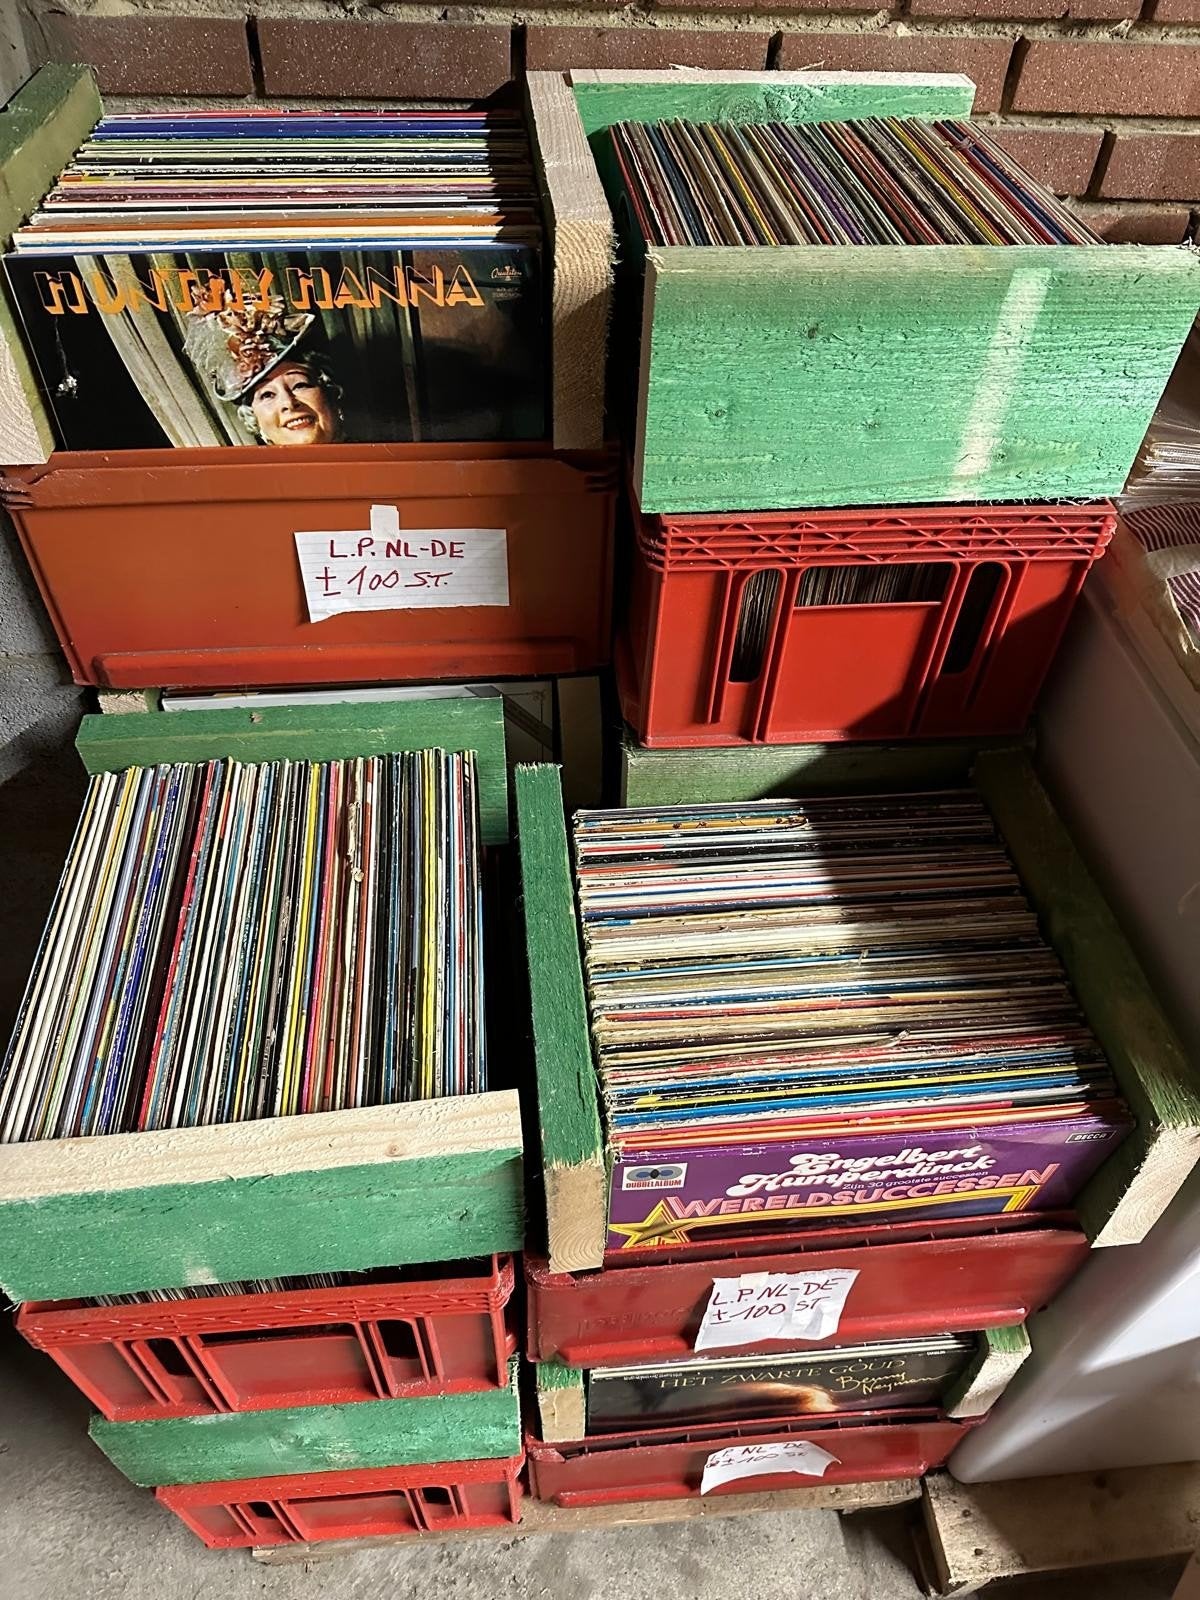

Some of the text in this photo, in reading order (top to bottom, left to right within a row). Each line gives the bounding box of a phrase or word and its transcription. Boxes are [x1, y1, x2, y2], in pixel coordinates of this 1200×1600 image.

[329, 537, 466, 559] L.P. NL-DE
[347, 565, 399, 595] 100
[789, 1144, 984, 1176] Engelbert
[665, 1163, 1060, 1219] WERELDSUCCESSEN
[726, 1155, 997, 1197] Humperdinck
[885, 1175, 931, 1188] grootste
[933, 1170, 990, 1181] successen
[757, 1277, 848, 1302] NL-DE
[660, 1375, 714, 1389] HET
[721, 1366, 822, 1384] ZWARTE
[829, 1359, 906, 1375] GOUD
